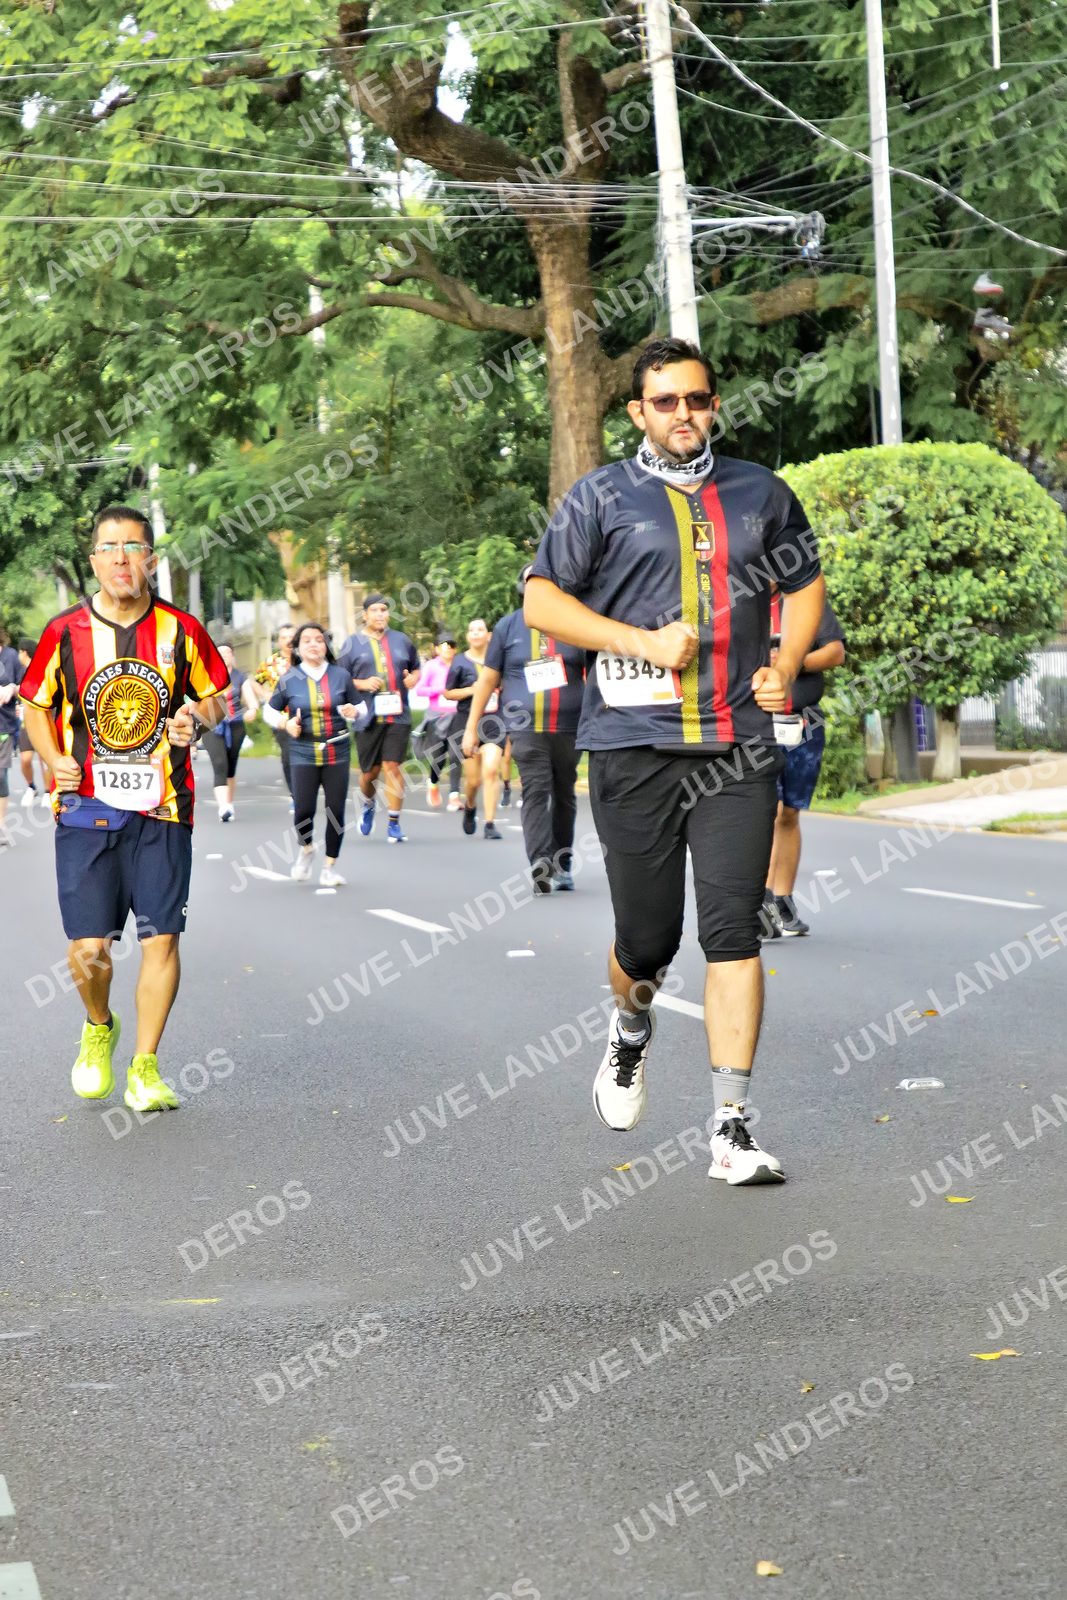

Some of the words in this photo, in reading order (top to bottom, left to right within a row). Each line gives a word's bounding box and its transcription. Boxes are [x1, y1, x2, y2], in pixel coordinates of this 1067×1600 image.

[86, 664, 122, 710] LEONES
[127, 662, 168, 708] NEGROS
[98, 770, 154, 790] 12837
